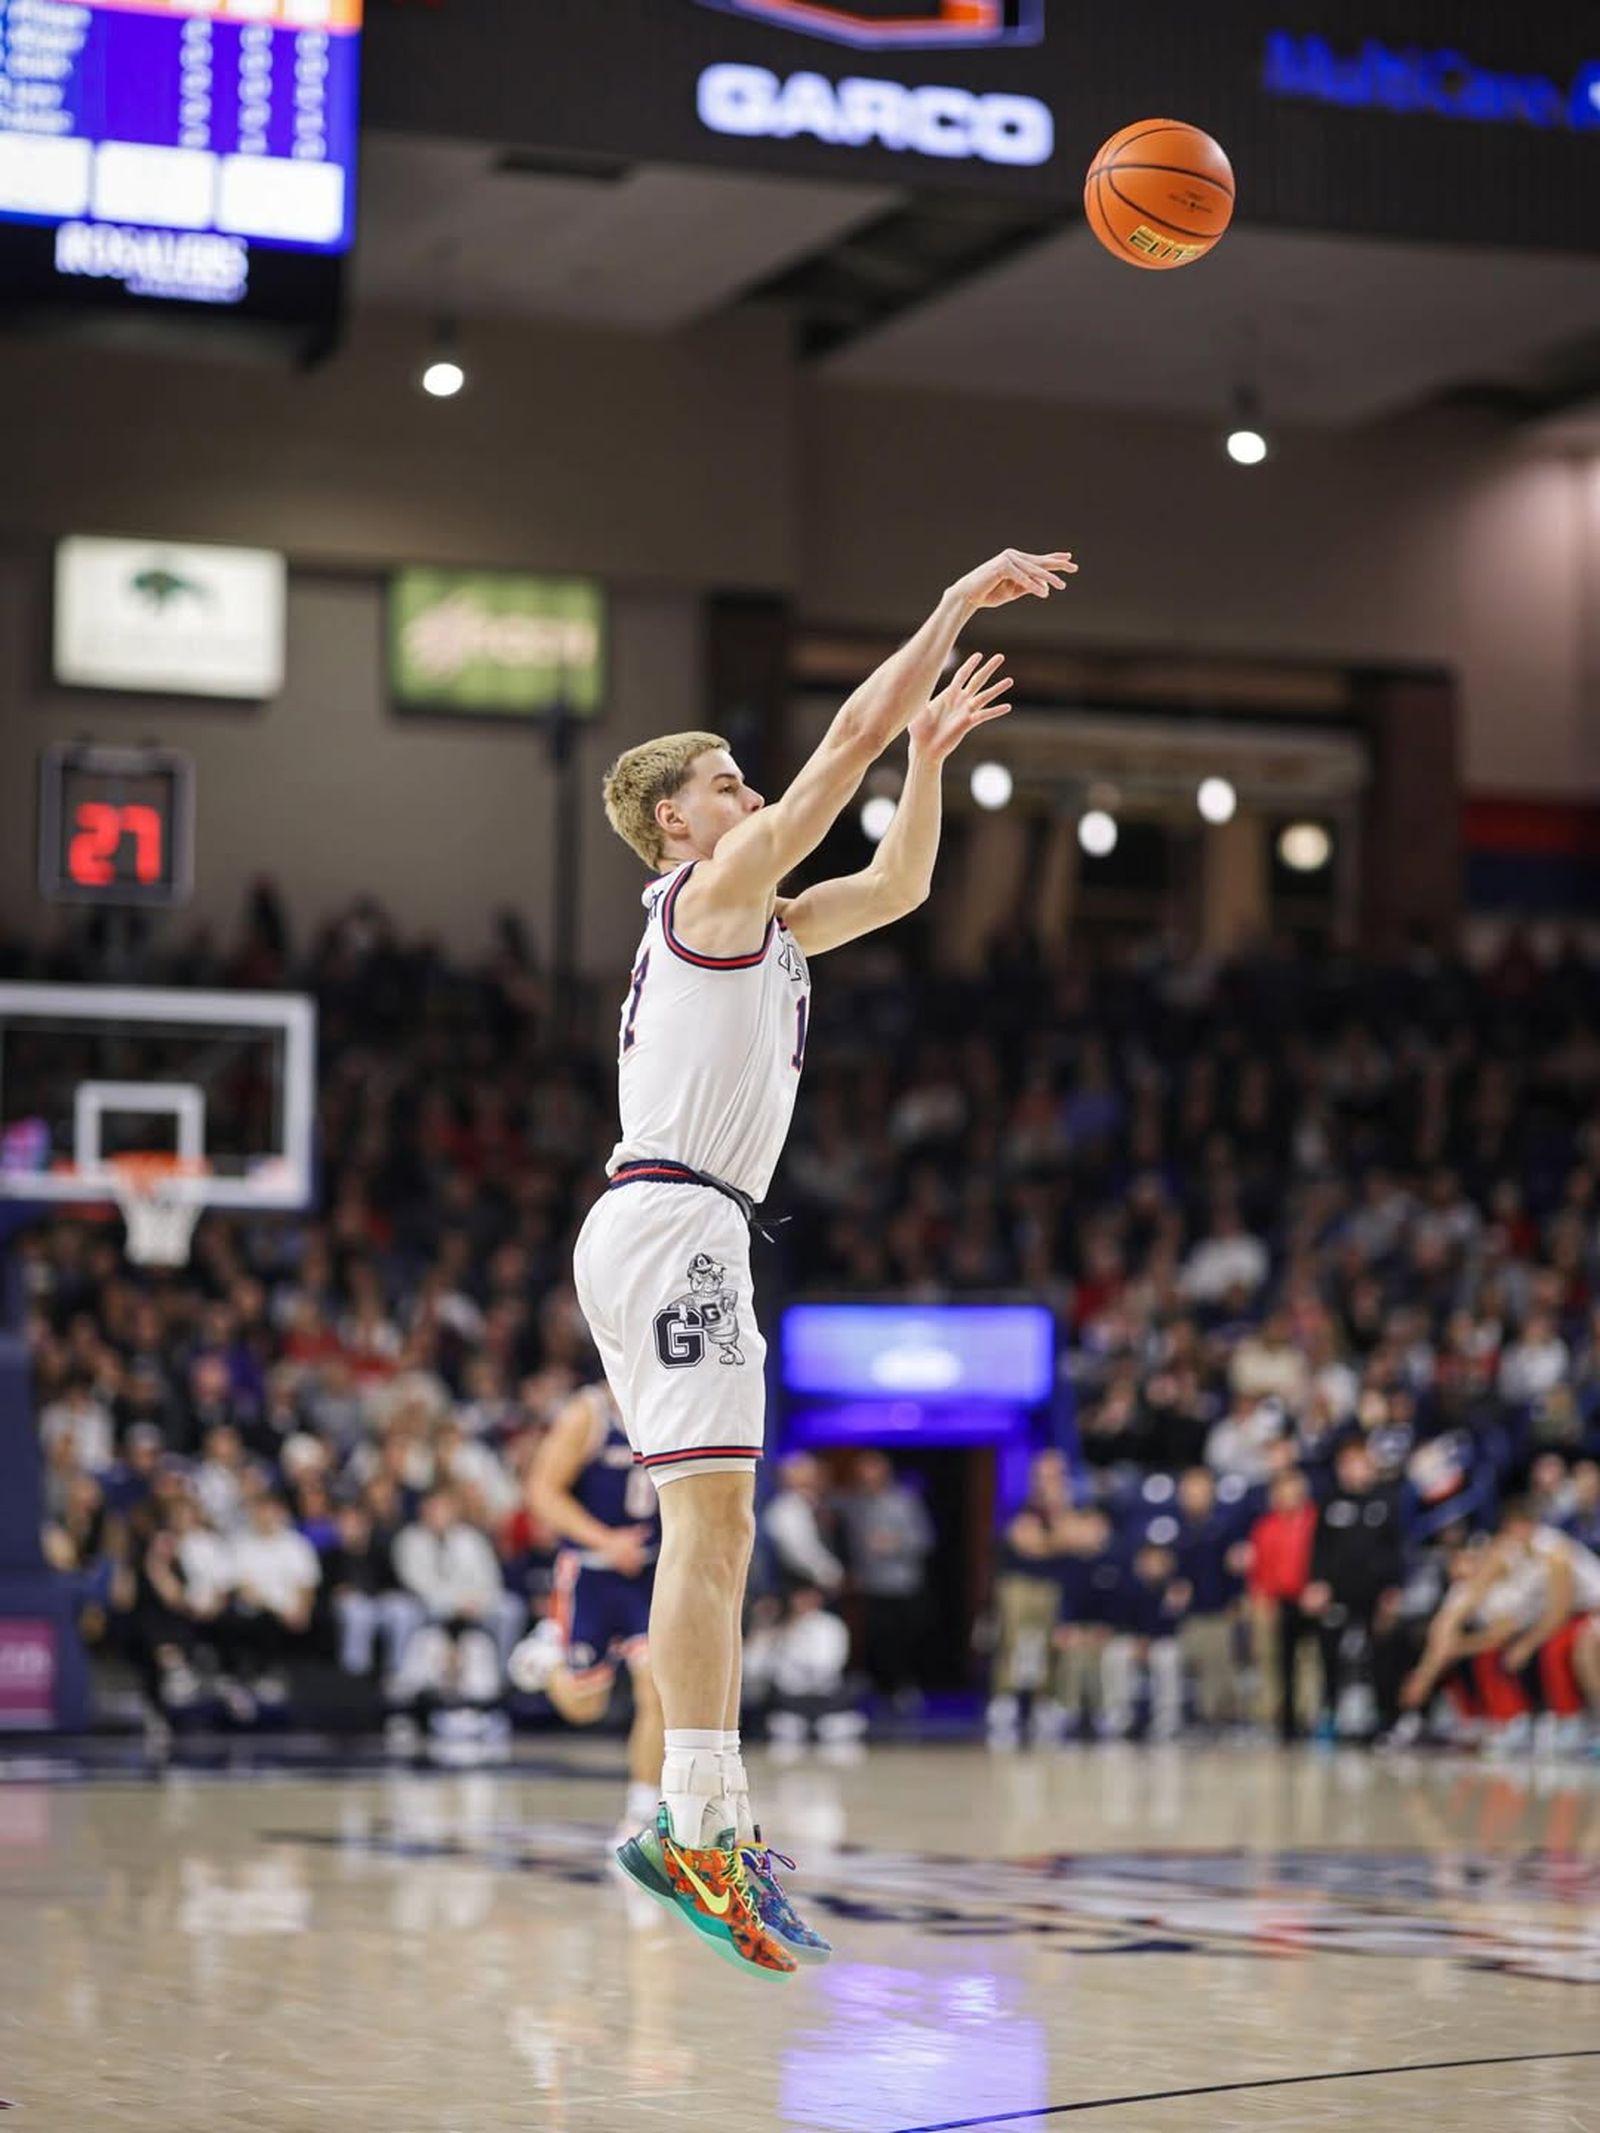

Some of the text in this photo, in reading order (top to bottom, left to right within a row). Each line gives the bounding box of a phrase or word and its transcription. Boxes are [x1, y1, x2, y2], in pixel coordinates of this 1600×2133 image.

[697, 62, 1055, 166] GARCO
[1264, 30, 1562, 129] MultiCare
[69, 801, 162, 886] 27
[653, 1308, 705, 1369] G
